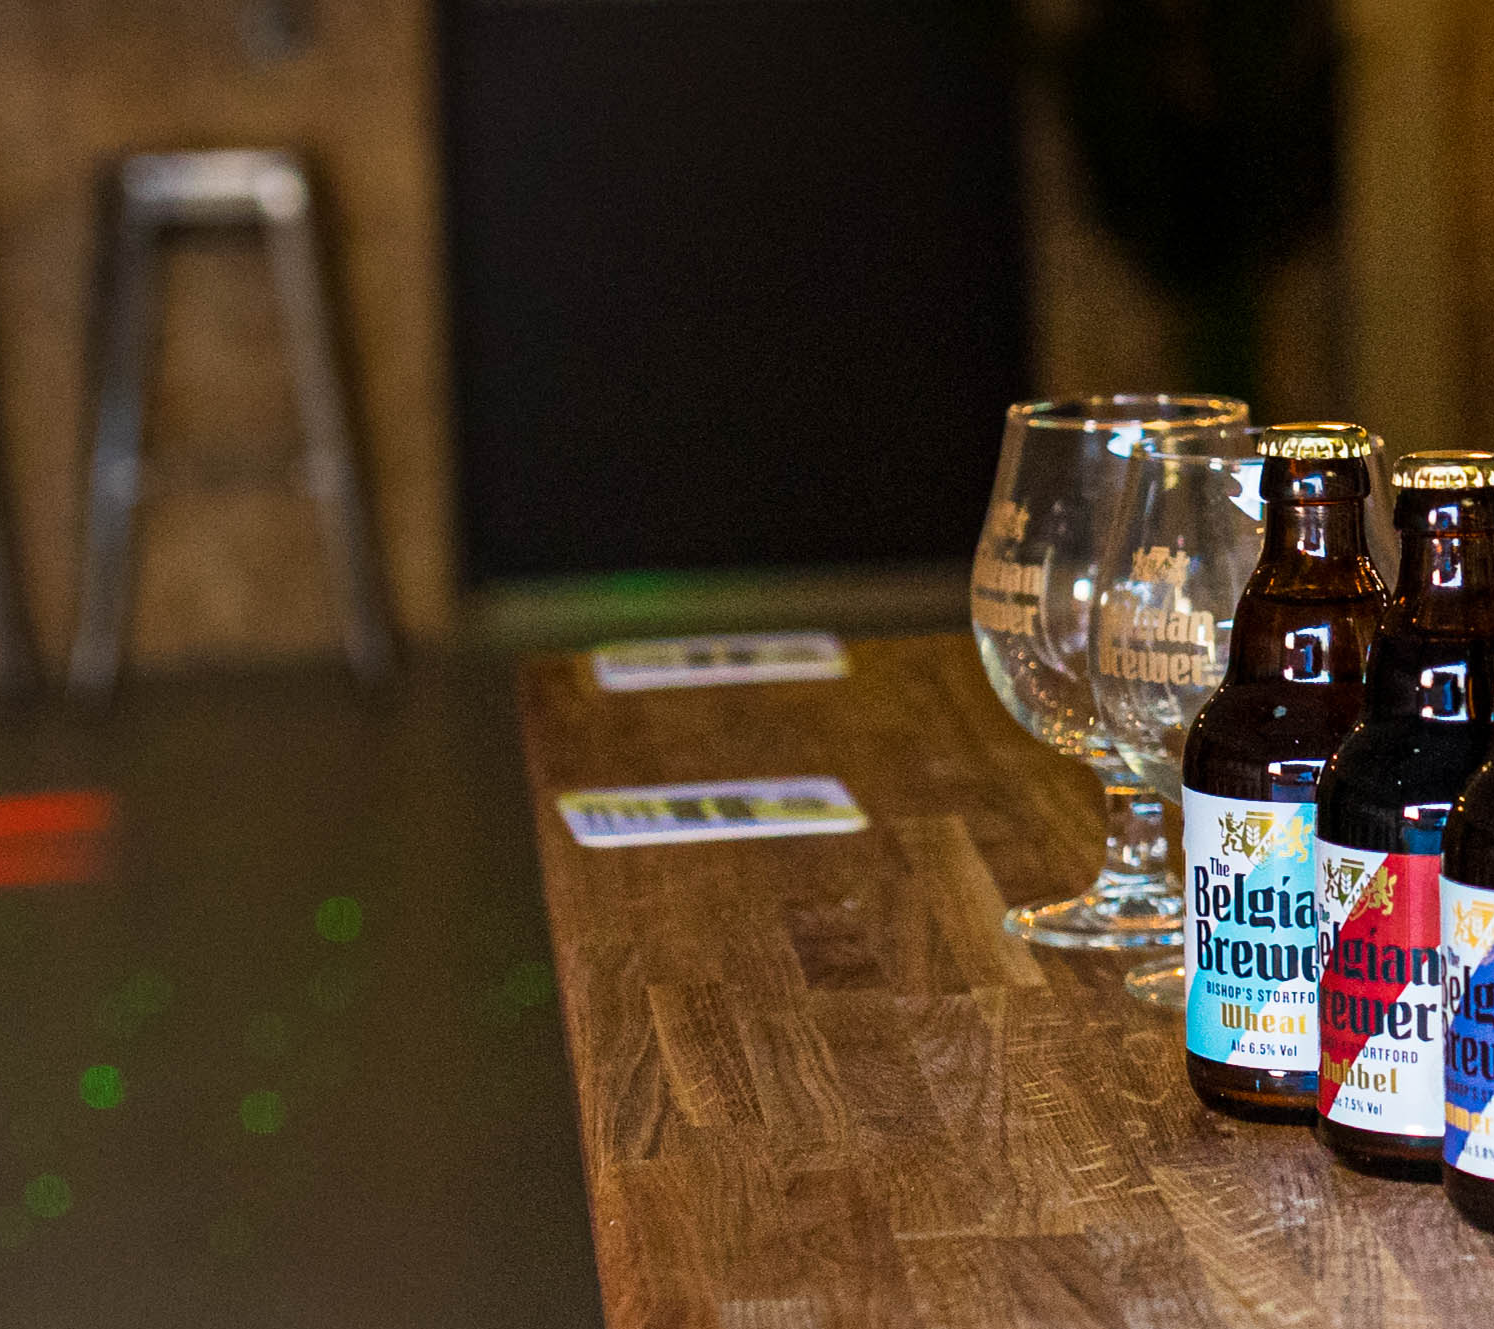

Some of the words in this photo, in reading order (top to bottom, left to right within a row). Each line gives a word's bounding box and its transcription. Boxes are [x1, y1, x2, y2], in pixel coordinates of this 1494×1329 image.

[1209, 856, 1231, 878] The
[1316, 913, 1443, 987] elgian
[1206, 979, 1253, 1002] BISHOP'S
[1220, 1001, 1308, 1035] Wheat
[1317, 985, 1438, 1043] rewer
[1230, 1038, 1246, 1054] Alc
[1249, 1041, 1276, 1057] 6.5%
[1279, 1043, 1298, 1057] Vol
[1321, 1051, 1399, 1094] Dubbel
[1367, 1101, 1383, 1117] Vol
